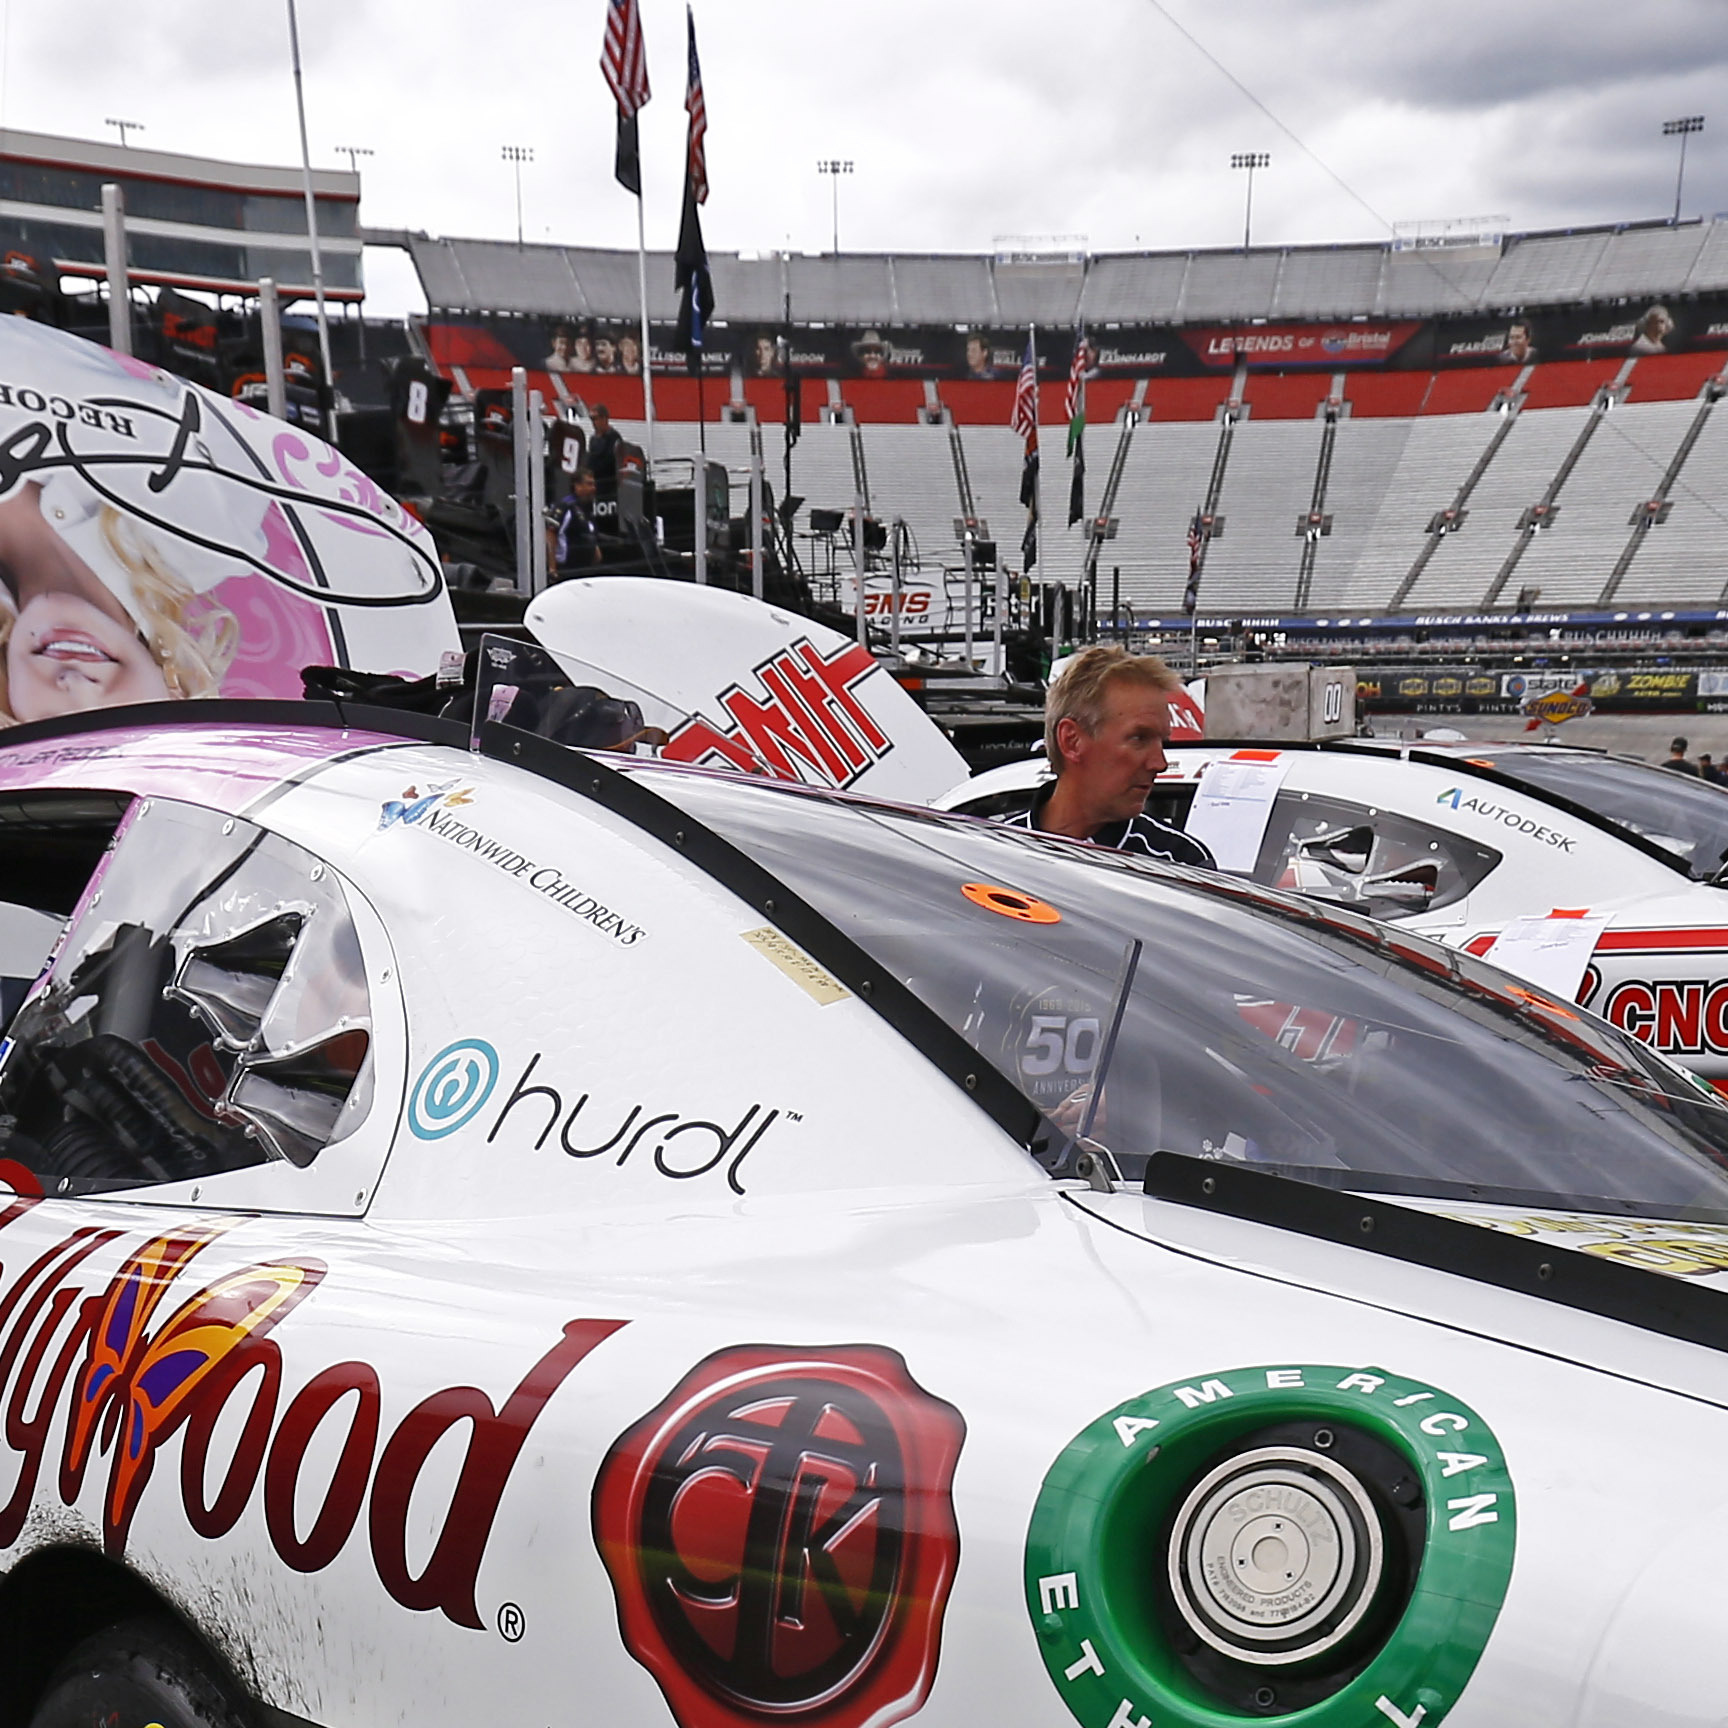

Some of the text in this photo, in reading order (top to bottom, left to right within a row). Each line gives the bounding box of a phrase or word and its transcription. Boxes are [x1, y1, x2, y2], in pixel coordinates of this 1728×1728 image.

[1208, 334, 1293, 356] LEGENDS
[1299, 336, 1315, 348] OF
[408, 381, 427, 422] 8
[561, 437, 580, 474] 9
[1627, 674, 1693, 689] ZOMBIE
[1525, 698, 1590, 715] SUNOCO
[418, 808, 647, 947] NATIONWIDE CHILDREN'S
[1021, 1014, 1103, 1076] 50
[489, 1053, 782, 1196] hurdl
[1112, 1369, 1501, 1534] AMERICAN
[1229, 1489, 1334, 1547] SCHULTZ
[1260, 1581, 1313, 1607] PRODUCTS
